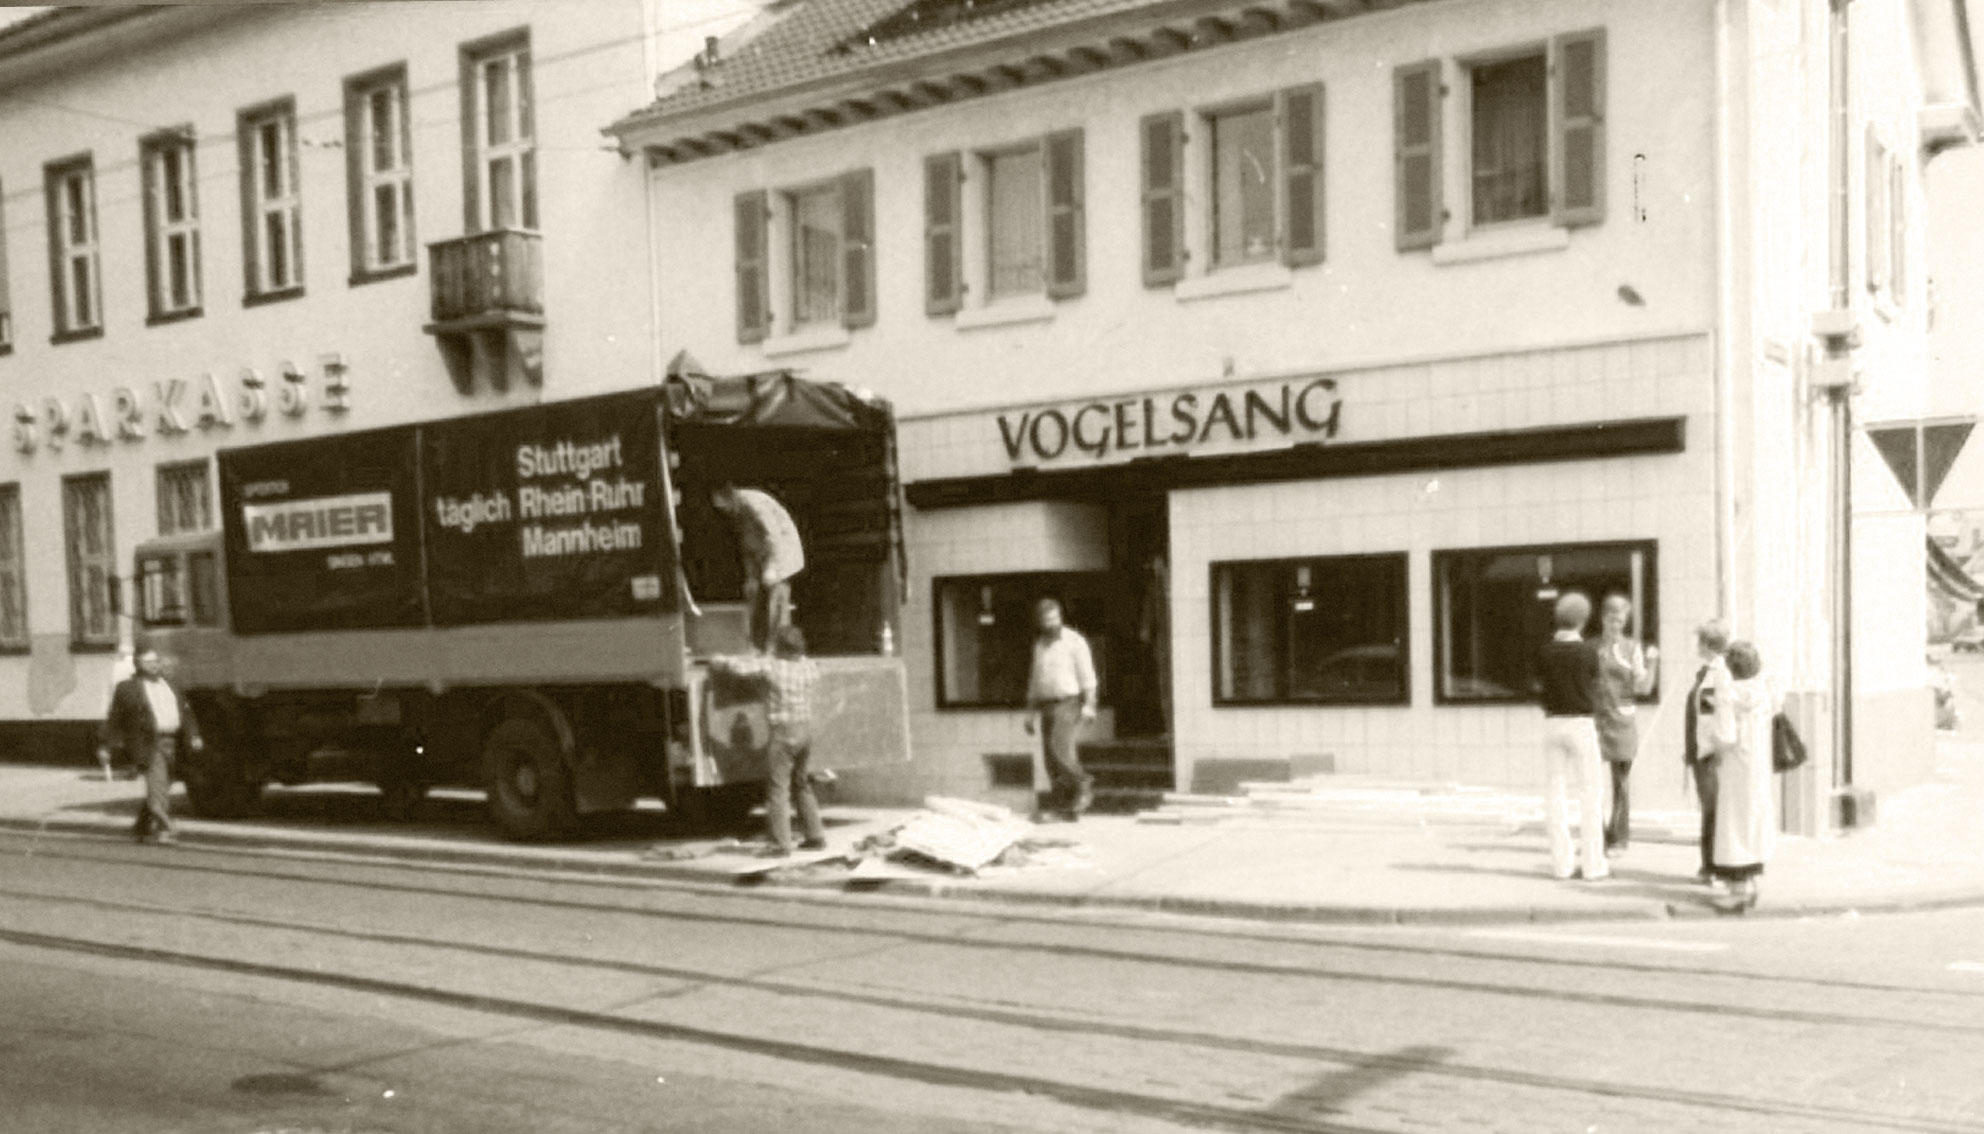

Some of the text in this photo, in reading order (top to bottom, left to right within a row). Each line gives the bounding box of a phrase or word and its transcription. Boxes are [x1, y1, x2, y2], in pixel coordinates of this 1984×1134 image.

[14, 353, 350, 455] SPARKASSE
[996, 379, 1342, 460] VOGELSANG
[517, 435, 623, 479] Stuttgart
[251, 503, 387, 543] MAIER
[436, 477, 645, 533] täglich Rhein-Ruhr
[522, 519, 642, 557] Mannheim
